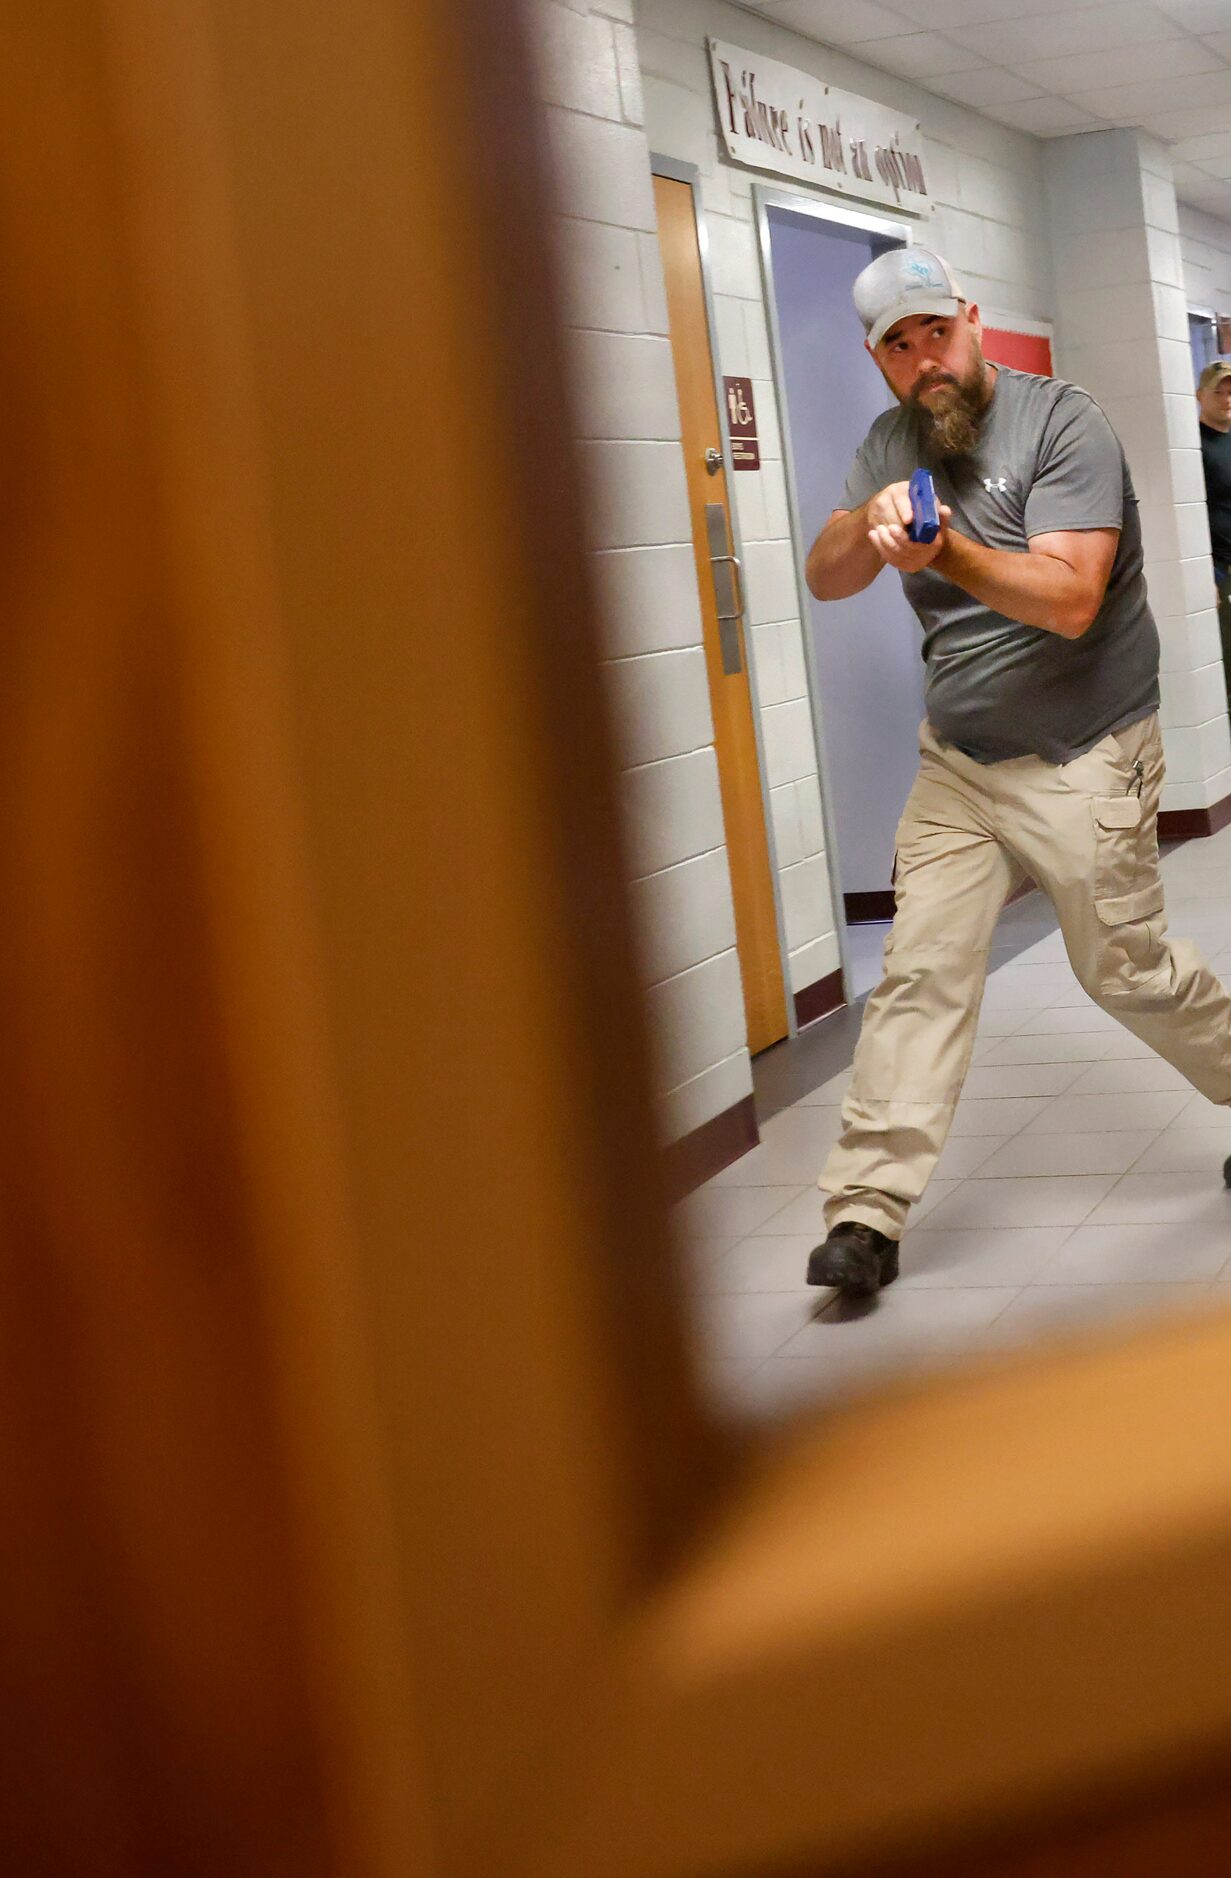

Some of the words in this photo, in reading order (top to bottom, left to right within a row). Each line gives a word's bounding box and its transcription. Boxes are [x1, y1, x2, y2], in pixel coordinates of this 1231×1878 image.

[719, 61, 792, 156] Failure
[798, 98, 815, 165] is
[819, 114, 847, 175] not
[850, 138, 873, 182] an
[875, 131, 927, 203] option
